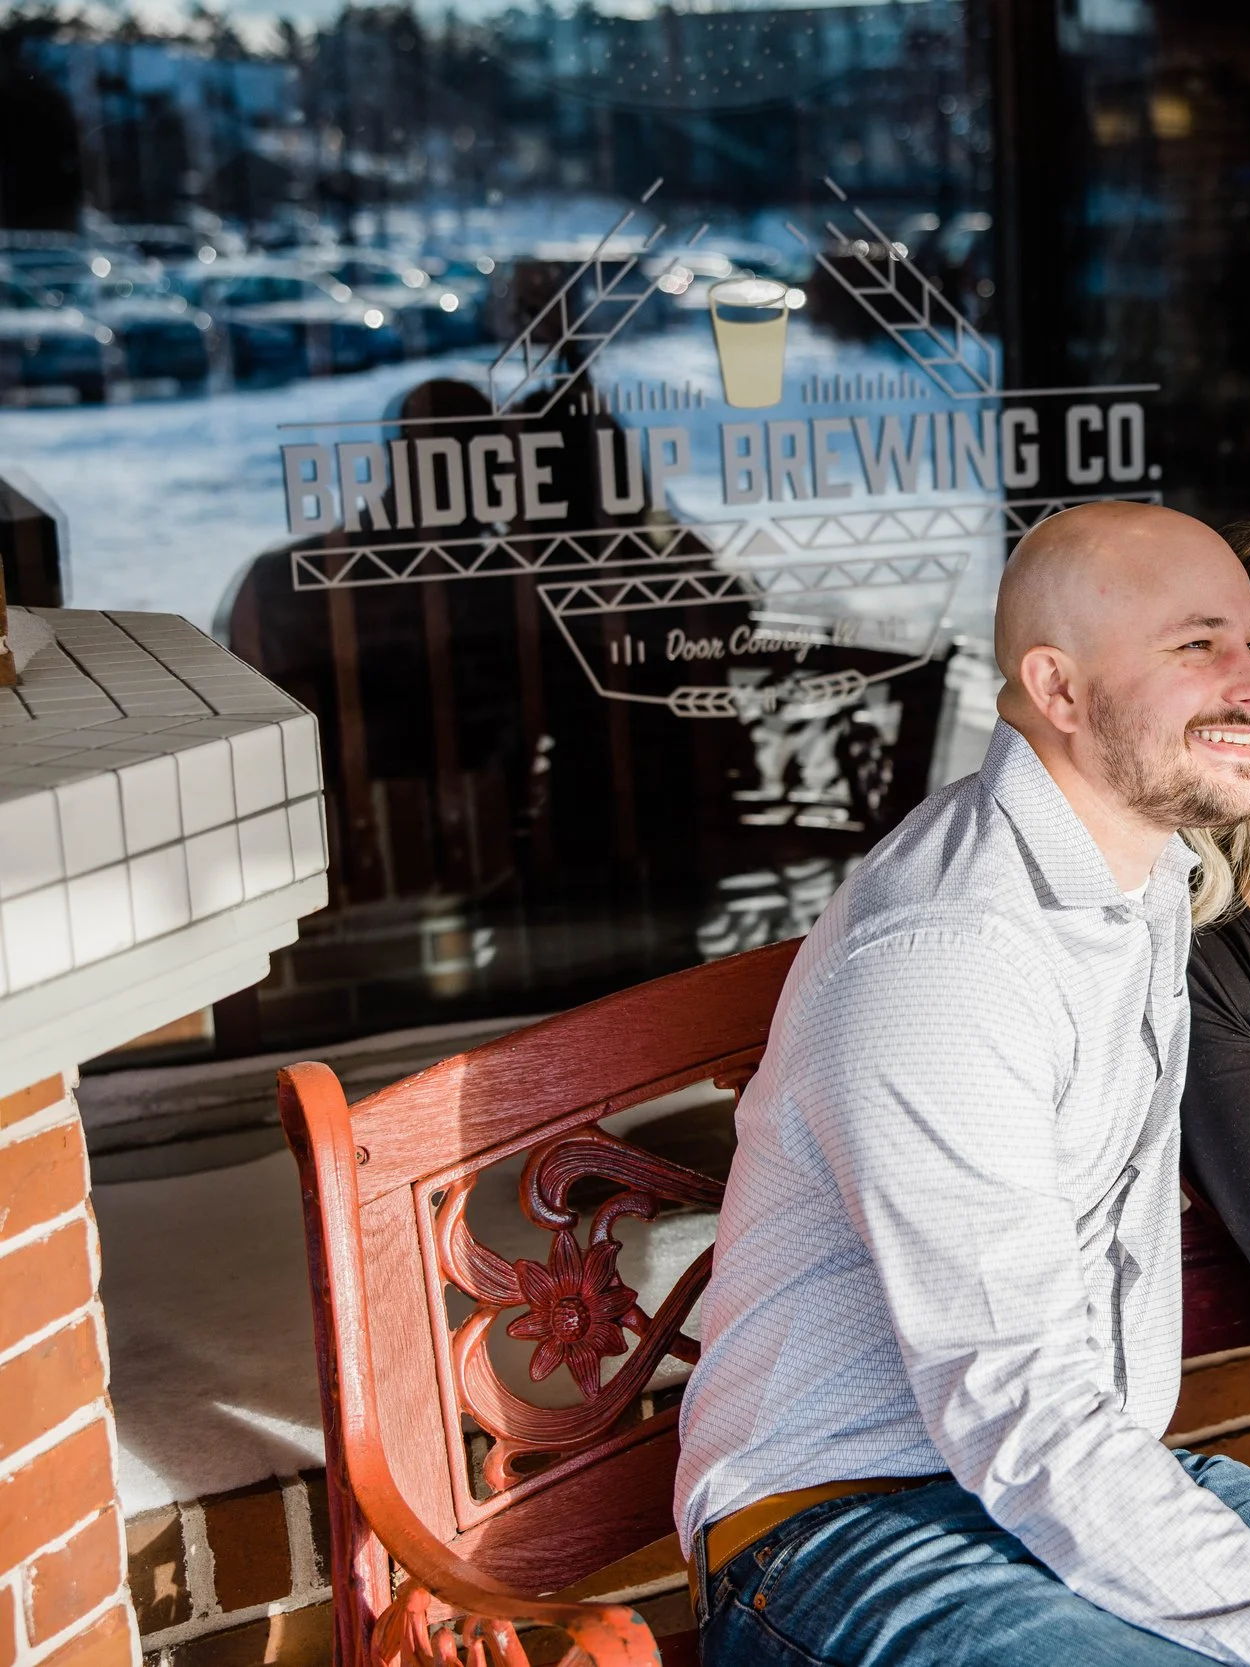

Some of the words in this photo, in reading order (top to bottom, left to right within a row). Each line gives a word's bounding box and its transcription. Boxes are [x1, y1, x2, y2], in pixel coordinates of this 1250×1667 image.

[281, 431, 569, 534] BRIDGE
[599, 426, 692, 515] UP
[721, 409, 1040, 504] BREWING
[1066, 403, 1163, 484] CO.
[666, 628, 725, 661] Door
